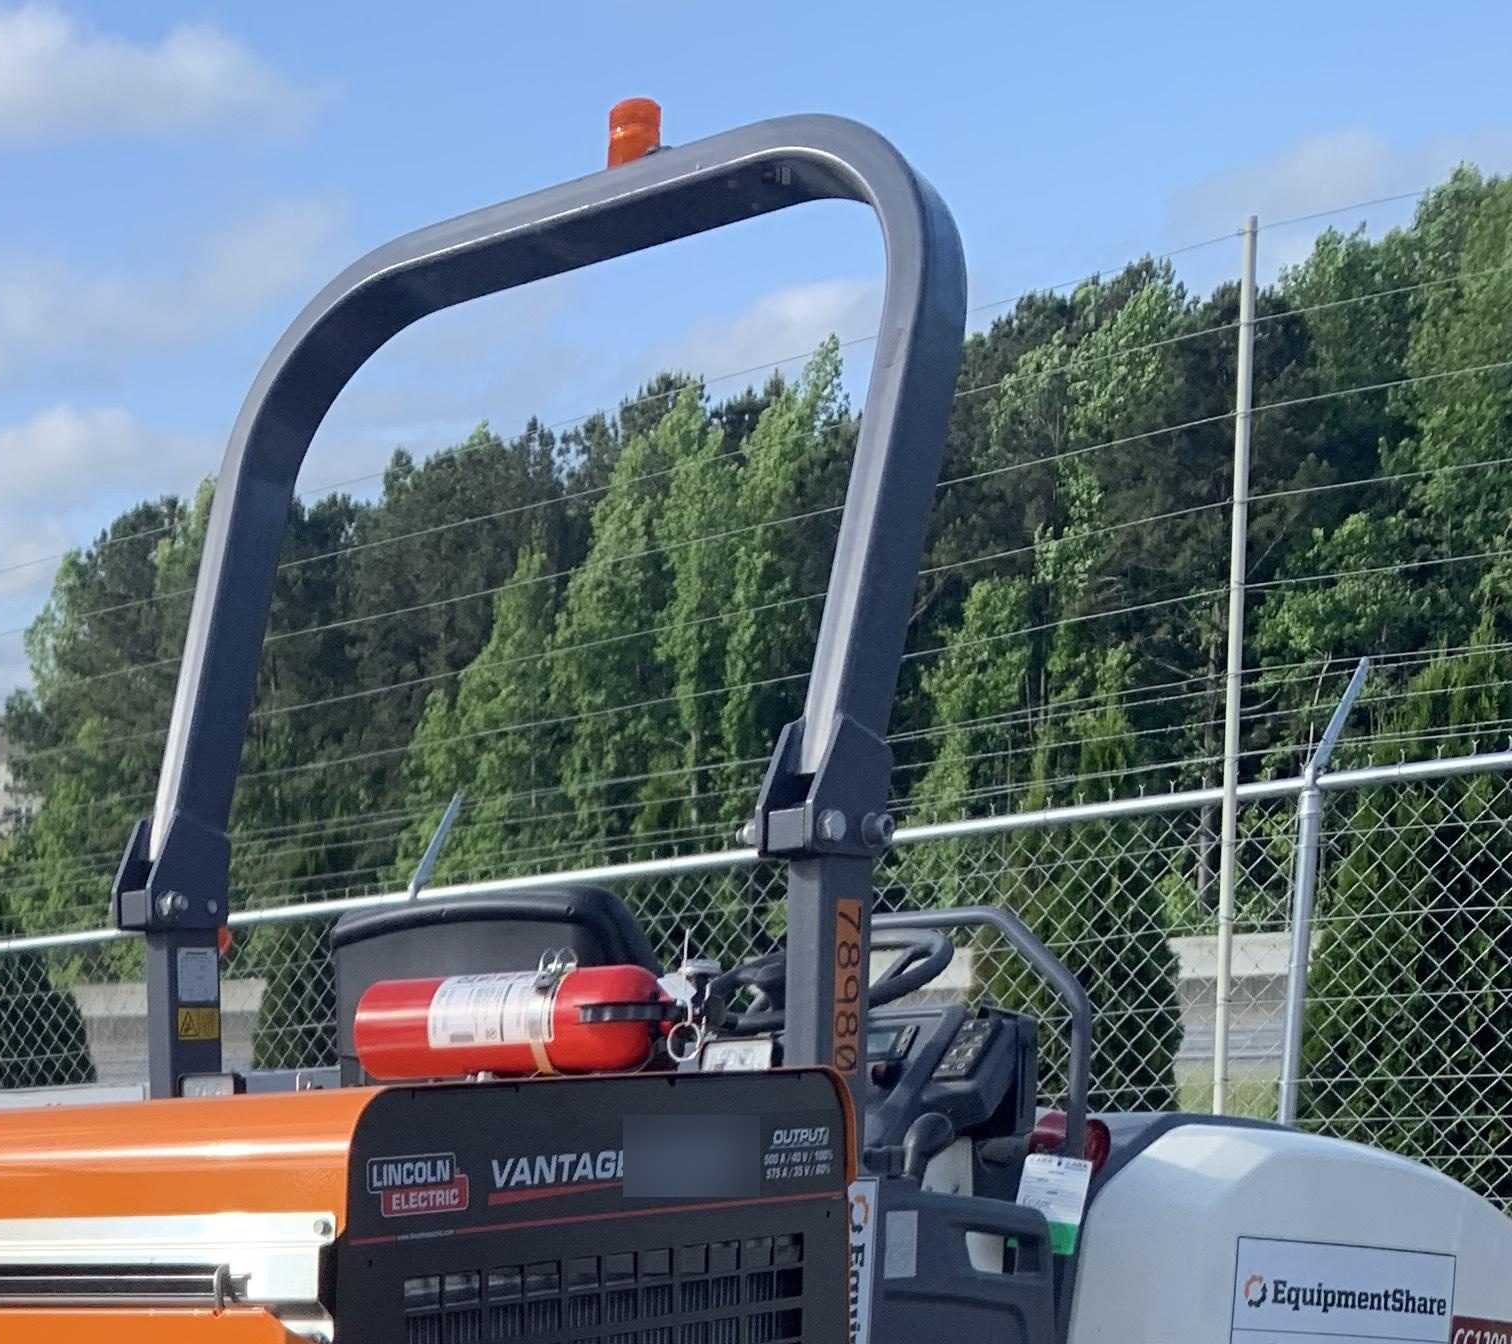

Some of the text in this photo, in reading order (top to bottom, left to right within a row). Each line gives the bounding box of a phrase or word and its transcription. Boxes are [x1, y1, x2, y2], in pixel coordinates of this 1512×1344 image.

[773, 1127, 826, 1145] OUTPUT
[372, 1160, 450, 1187] LINCOLN
[391, 1188, 459, 1211] ELECTRIC
[1272, 1280, 1447, 1317] EquipmentShare
